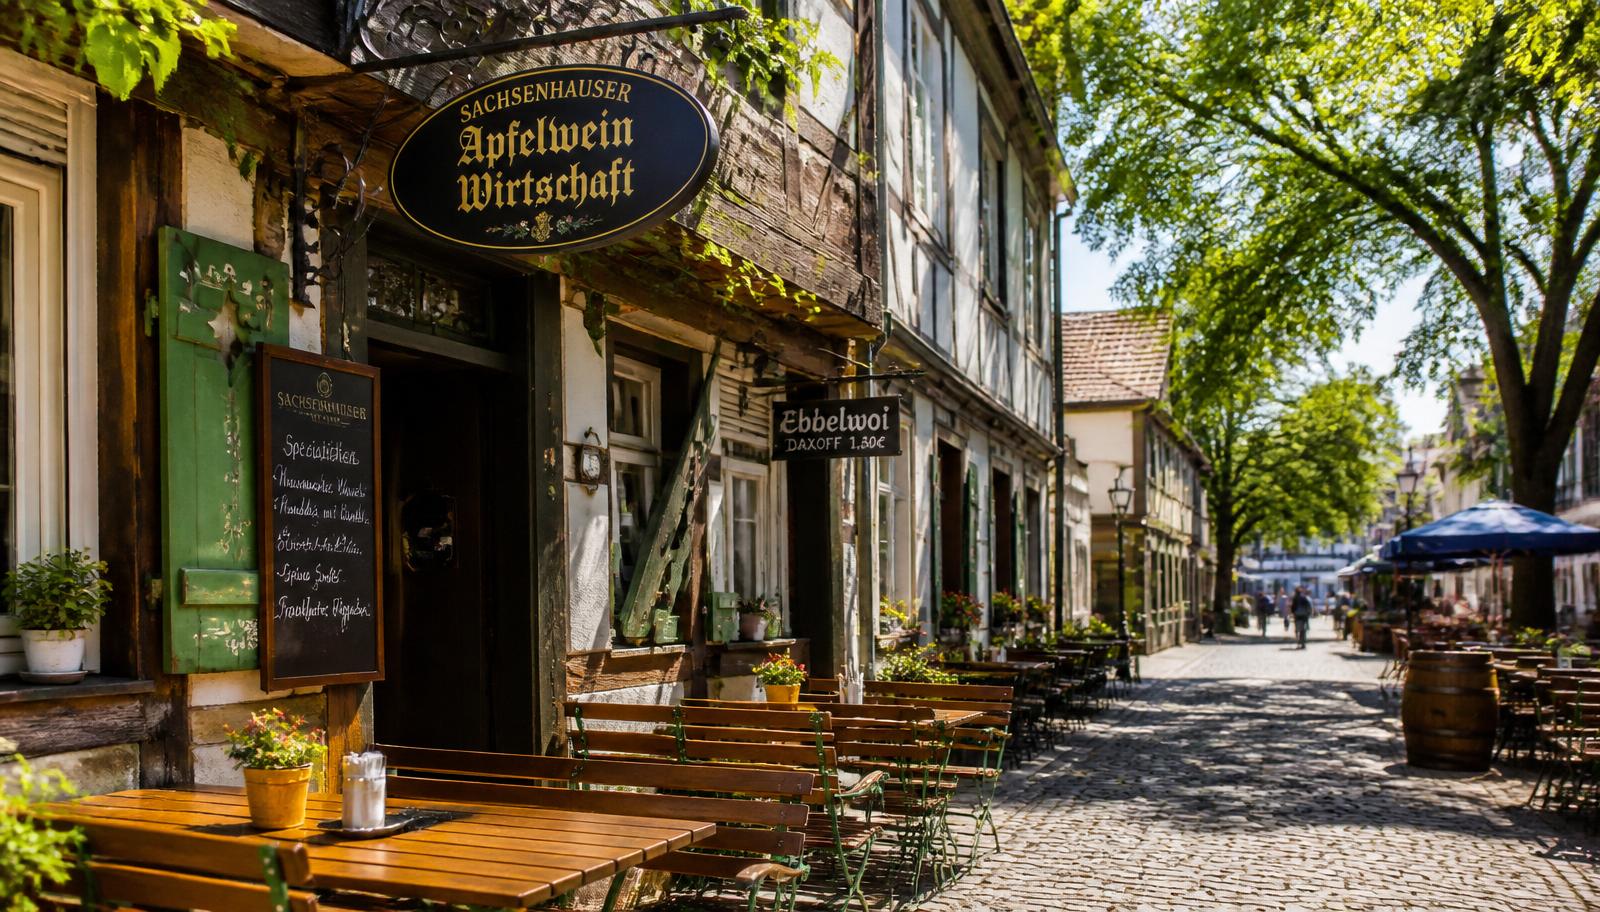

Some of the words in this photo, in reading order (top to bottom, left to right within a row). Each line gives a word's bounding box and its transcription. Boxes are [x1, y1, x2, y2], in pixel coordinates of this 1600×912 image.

[460, 79, 632, 123] SACHSENHAUSER
[457, 109, 634, 169] Apfelwein
[457, 157, 635, 213] Wirtschaft
[780, 405, 889, 434] Ebbelwoi
[785, 436, 842, 452] DAXOFF
